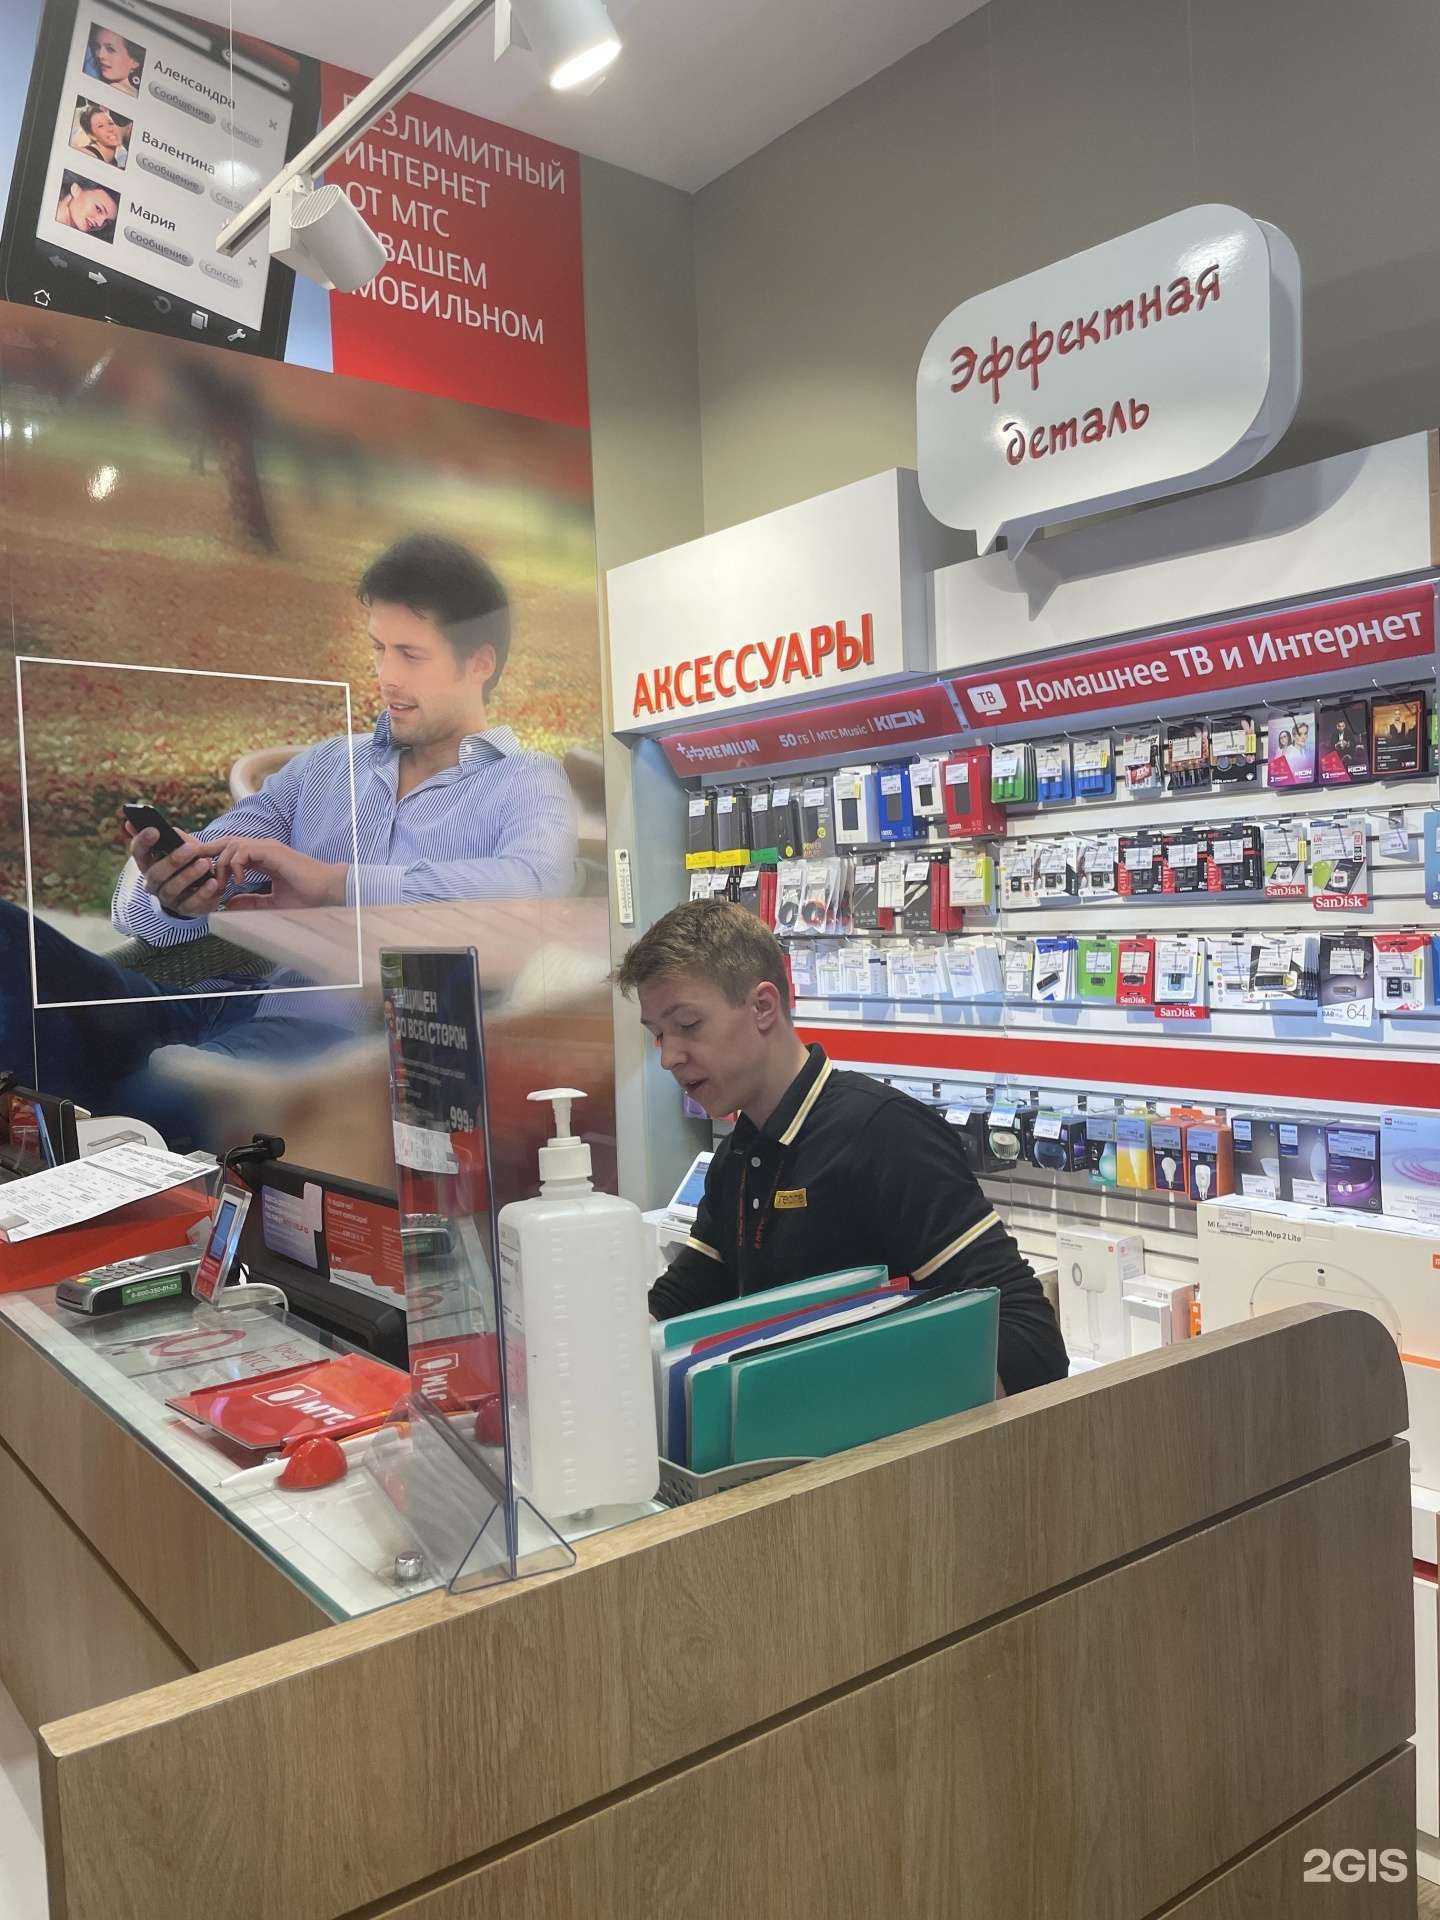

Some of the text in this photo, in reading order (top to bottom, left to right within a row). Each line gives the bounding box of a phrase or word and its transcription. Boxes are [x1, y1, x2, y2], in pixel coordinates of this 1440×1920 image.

[154, 60, 237, 110] Александра
[142, 131, 216, 176] Валентина
[343, 93, 566, 194] ЗЛИМИТНЫЙ
[345, 141, 491, 208] ИНТЕРНЕТ
[130, 202, 177, 232] Мария
[345, 181, 450, 238] ОТ МТС
[130, 230, 189, 263] Сообщение
[378, 232, 488, 290] ВАШЕМ
[950, 264, 1221, 404] Эффектная
[1002, 398, 1151, 466] деталь
[632, 613, 875, 718] АКСЕССУАРЫ
[1015, 610, 1423, 712] Домашнее ТВ и Интернет
[977, 689, 997, 705] ТВ
[778, 733, 798, 748] 50
[816, 729, 838, 744] МТС
[839, 724, 867, 741] Music
[873, 709, 926, 731] KION
[1265, 886, 1304, 896] SanDisk
[1316, 895, 1363, 908] SanDisk
[1119, 995, 1146, 1005] SanDisk
[1160, 1007, 1197, 1018] SanDisk
[1346, 1003, 1367, 1020] 64
[293, 1400, 357, 1425] МТС
